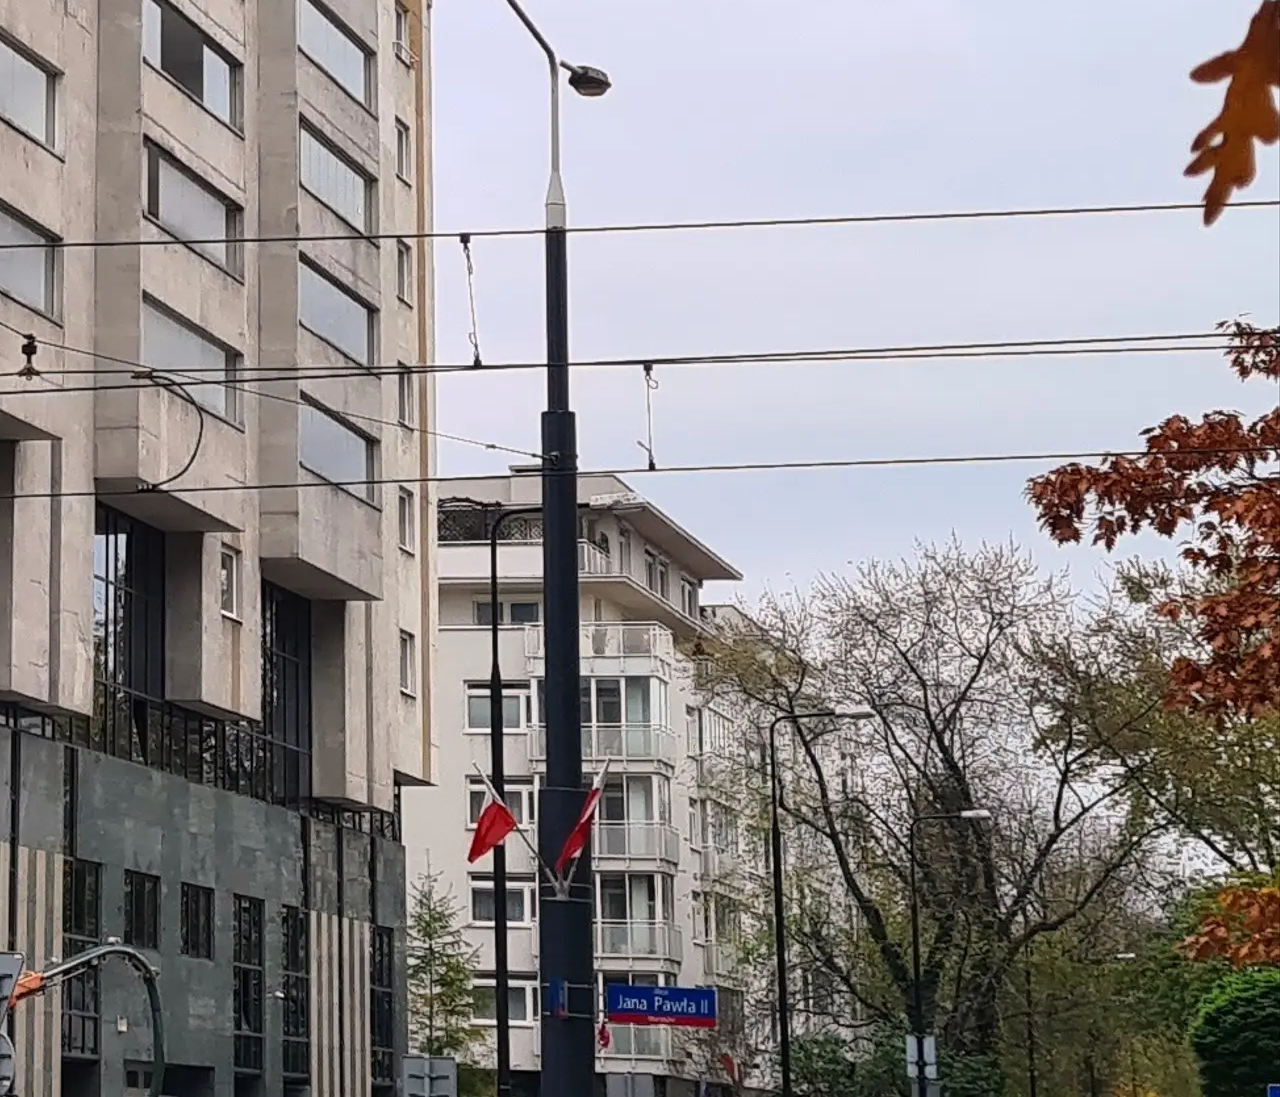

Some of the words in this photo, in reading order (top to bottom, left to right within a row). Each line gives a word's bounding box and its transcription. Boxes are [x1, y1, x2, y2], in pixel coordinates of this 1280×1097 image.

[617, 994, 647, 1010] Jana
[654, 996, 696, 1013] Pawła
[700, 999, 708, 1014] II
